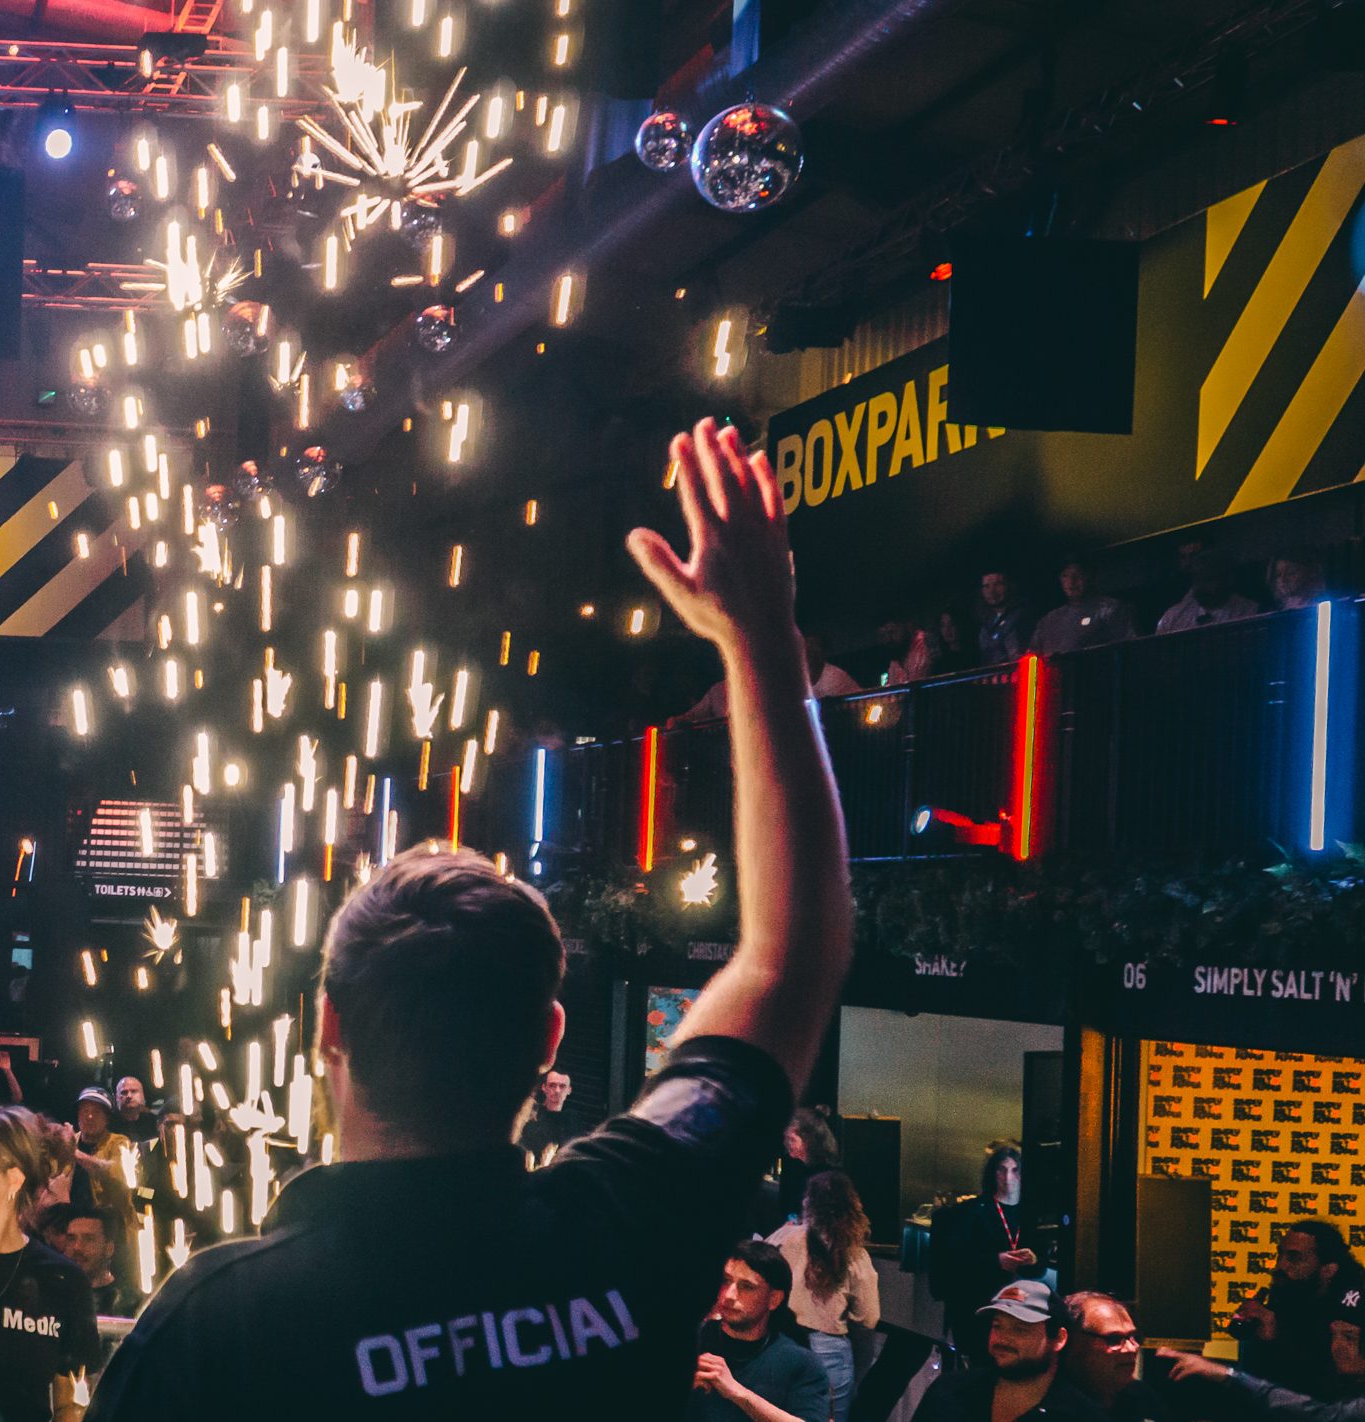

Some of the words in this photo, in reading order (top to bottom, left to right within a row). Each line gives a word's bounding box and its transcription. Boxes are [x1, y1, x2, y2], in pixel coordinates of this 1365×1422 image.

[777, 364, 1006, 516] BOXPAR
[94, 884, 136, 896] TOILETS
[1123, 962, 1147, 990] 06
[1193, 965, 1267, 997] SIMPLY
[1271, 969, 1325, 1001] SALT
[2, 1306, 62, 1338] Medic
